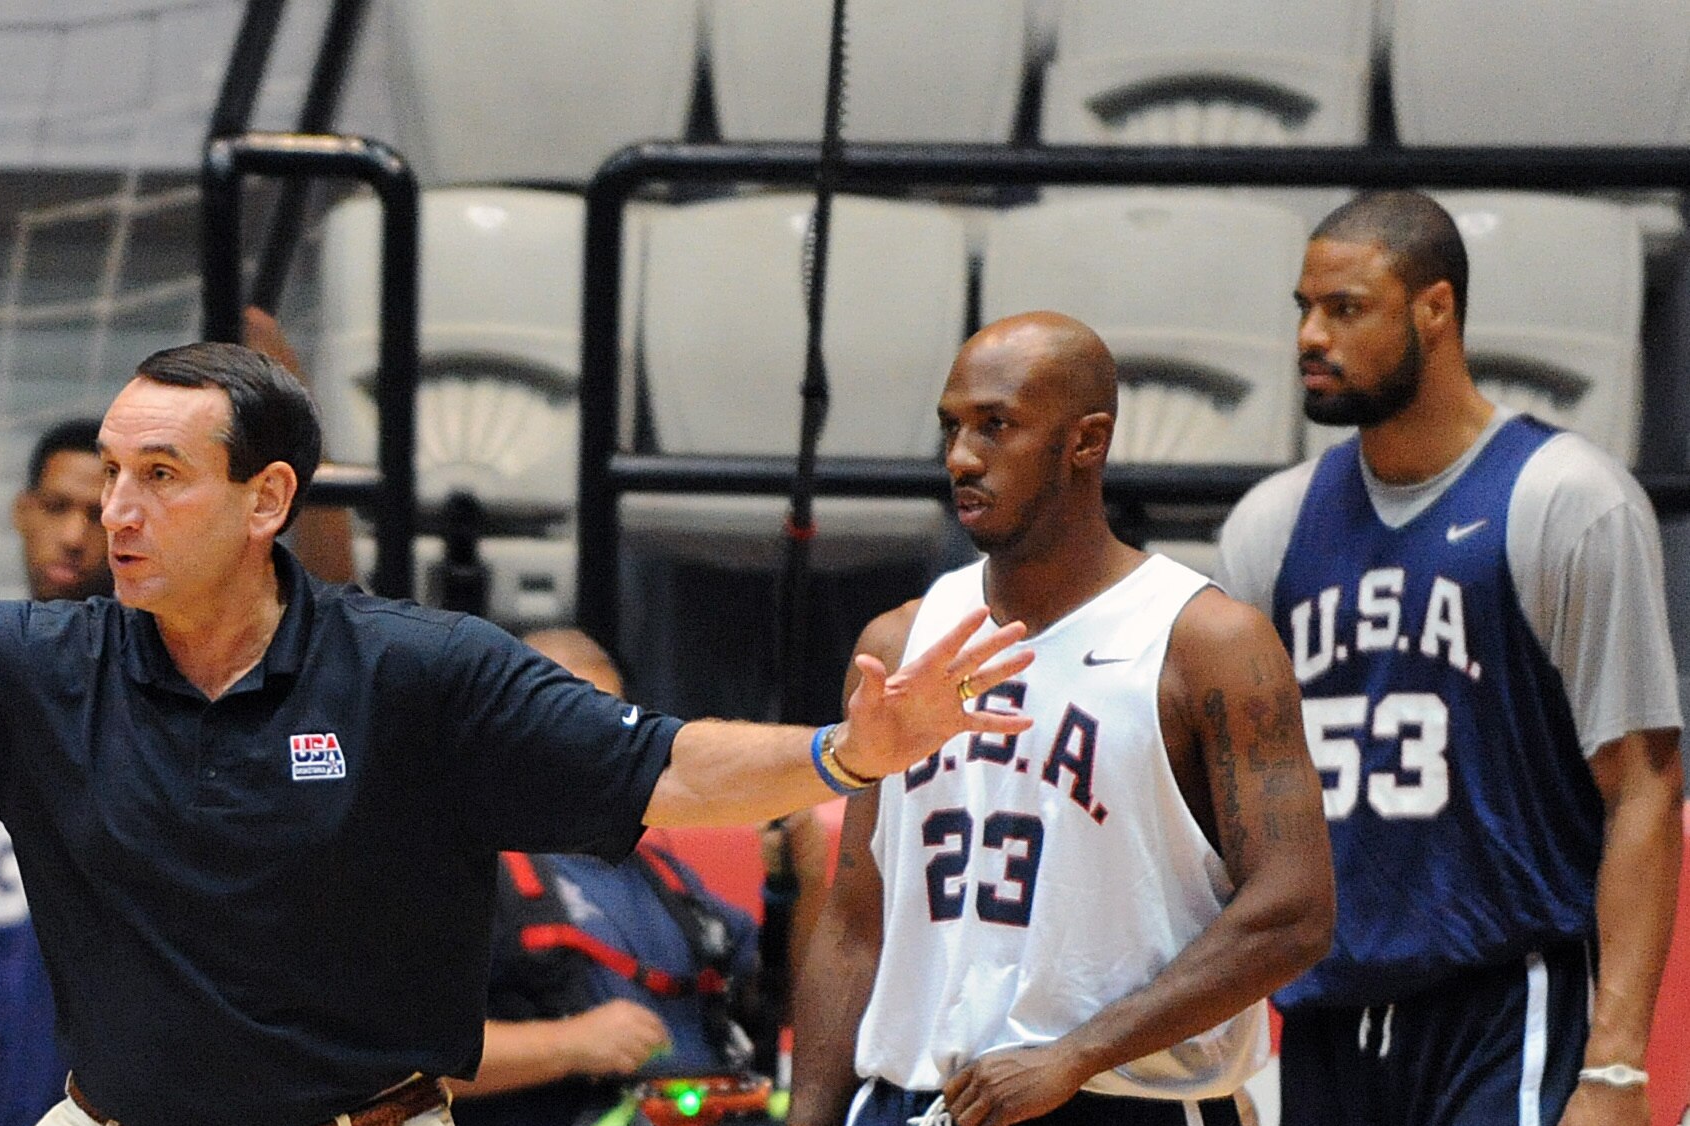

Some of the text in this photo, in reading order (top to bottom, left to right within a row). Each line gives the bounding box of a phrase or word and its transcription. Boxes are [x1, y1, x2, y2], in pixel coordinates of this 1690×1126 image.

[1291, 566, 1482, 681] U.S.A.
[292, 735, 341, 762] USA
[905, 679, 1108, 826] .S.A.
[1301, 692, 1449, 820] 53
[922, 807, 1044, 928] 23
